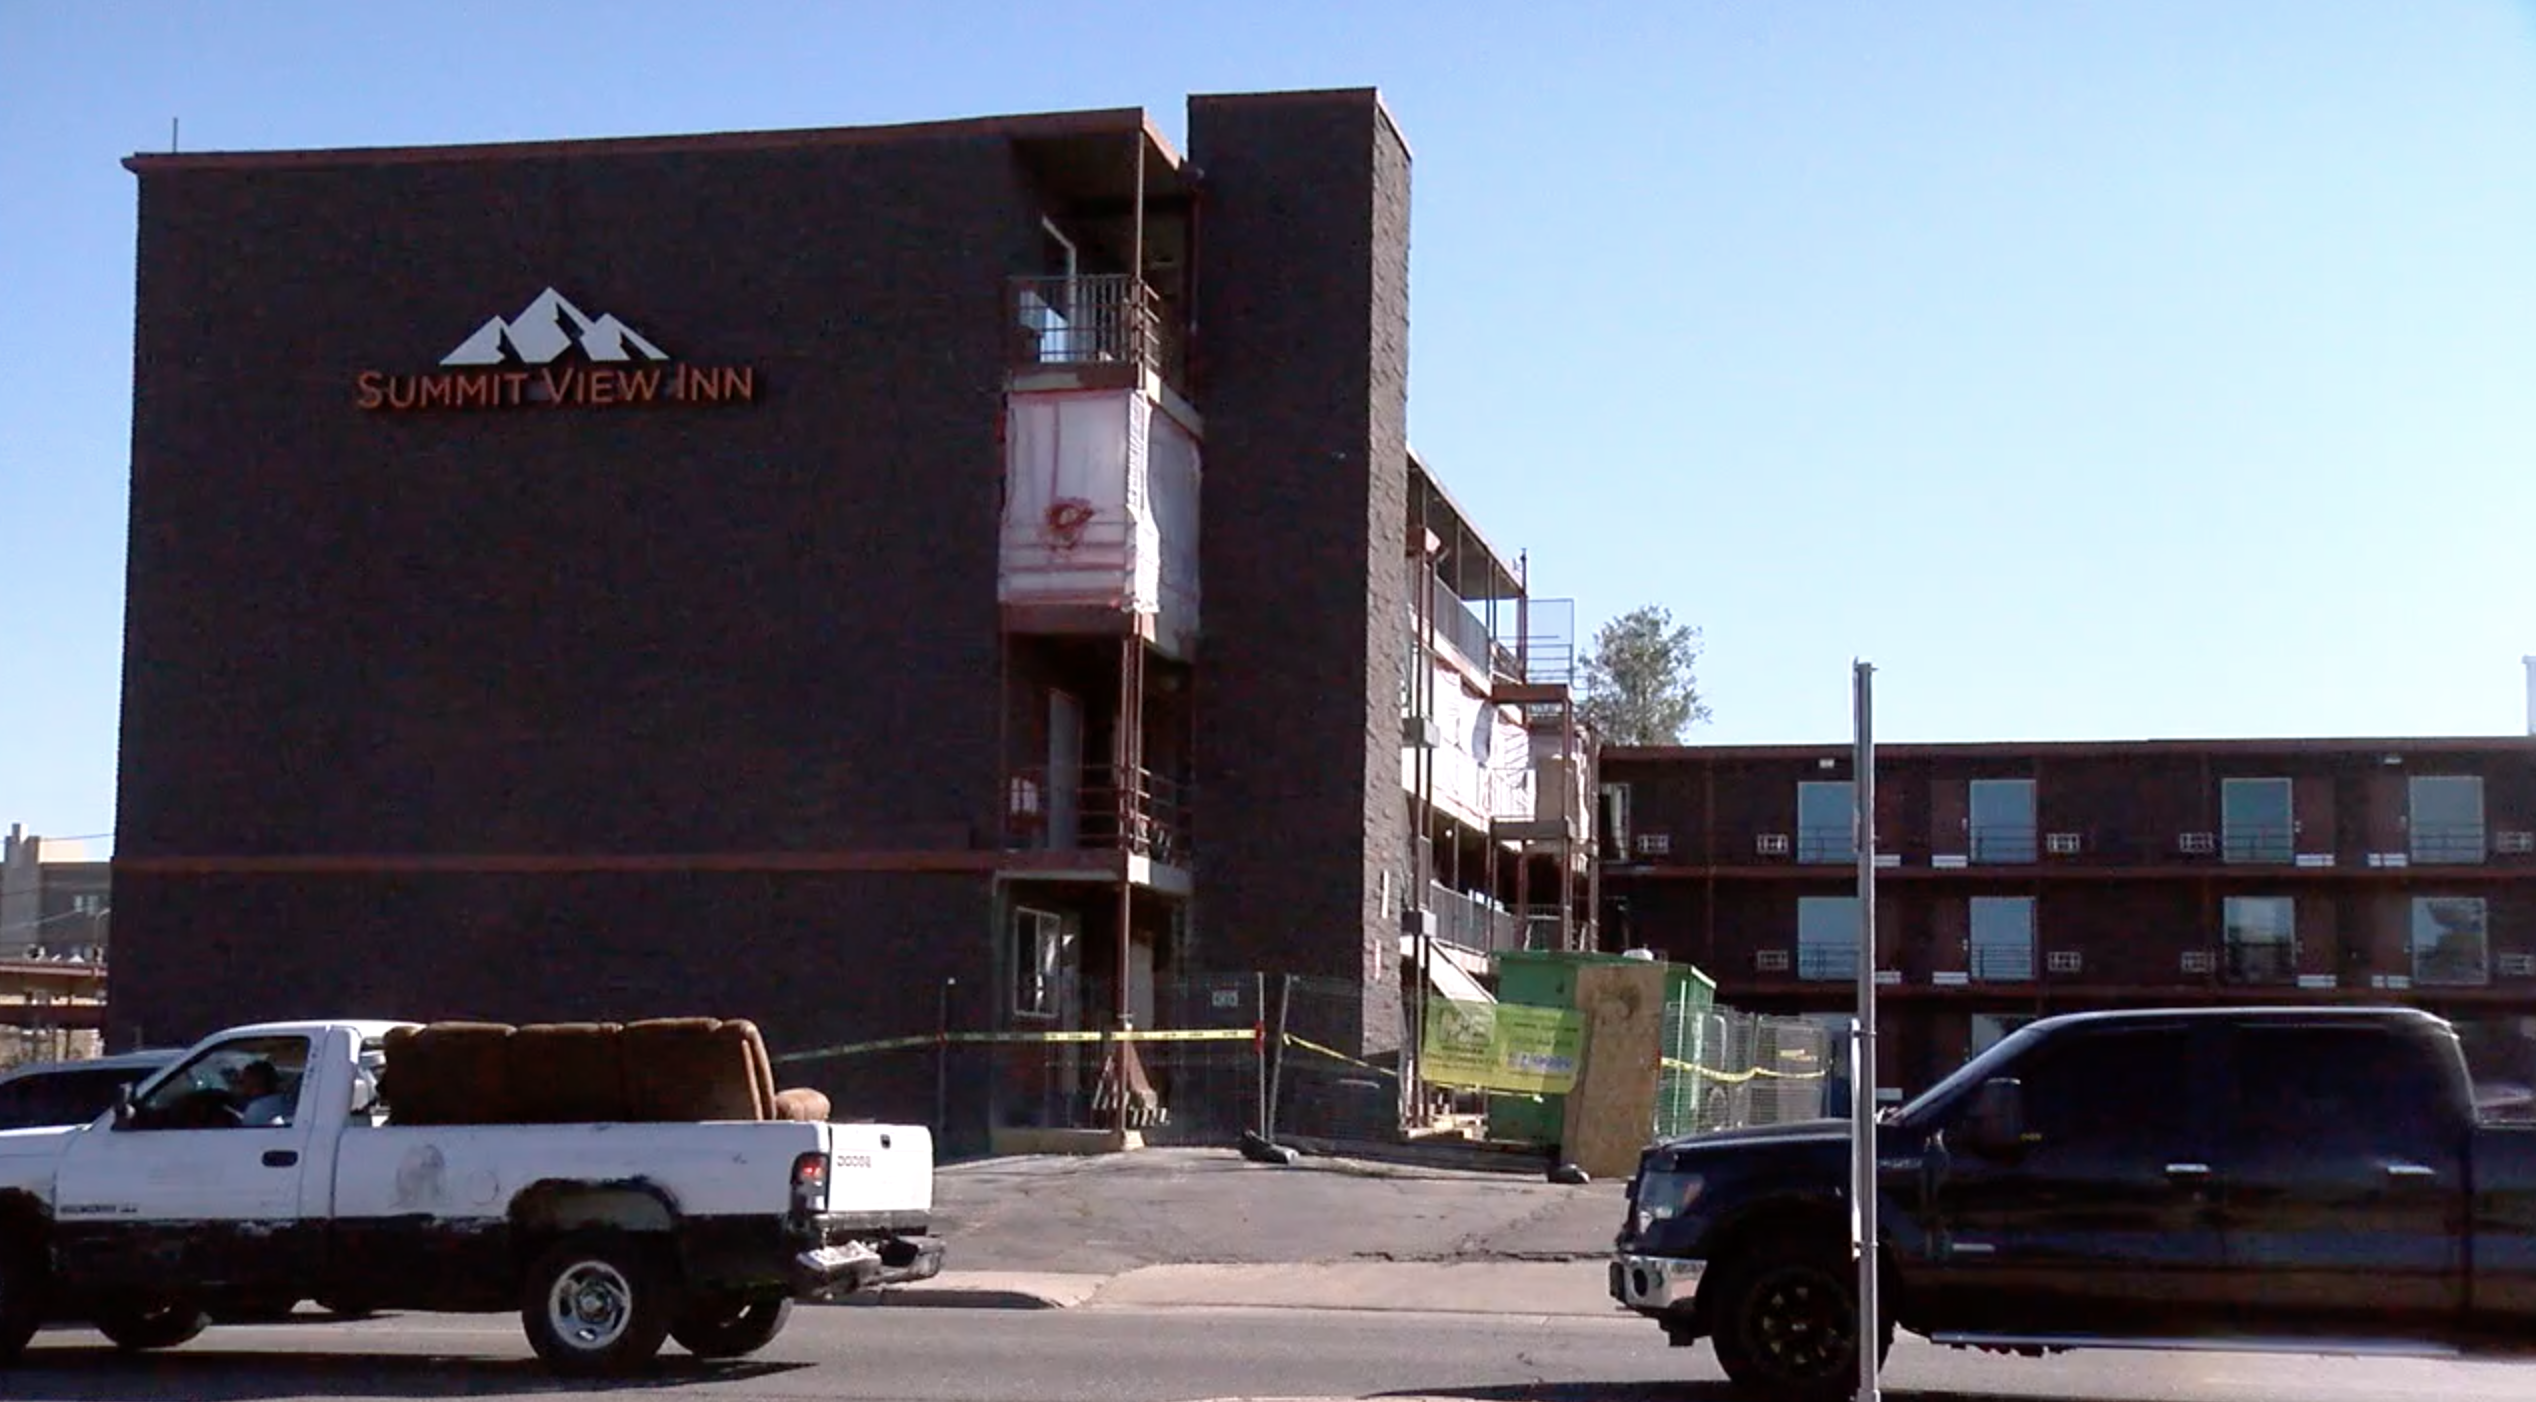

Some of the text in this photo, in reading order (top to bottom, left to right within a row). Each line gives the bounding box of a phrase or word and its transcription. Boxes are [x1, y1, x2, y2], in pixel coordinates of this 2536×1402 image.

[357, 364, 754, 409] SUMMIT VIEW INN
